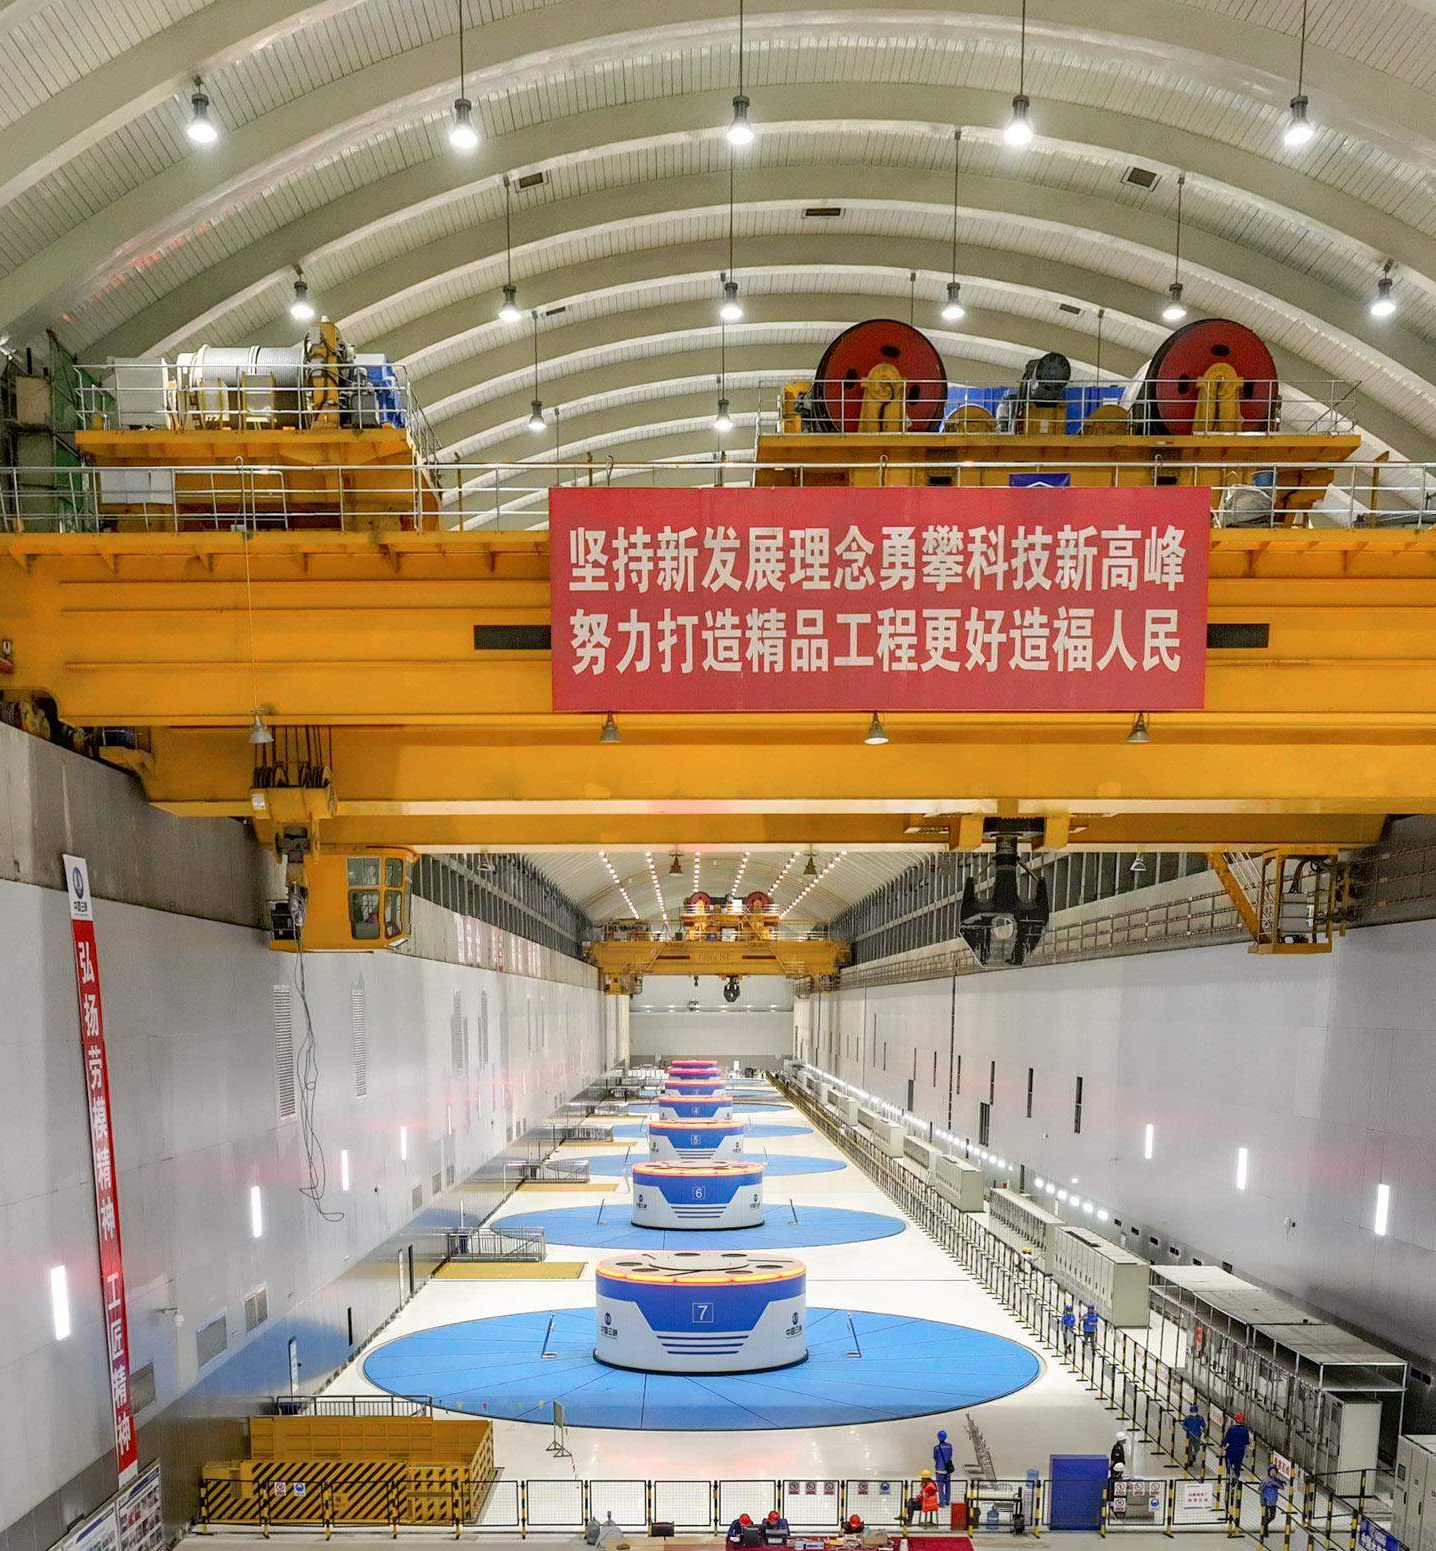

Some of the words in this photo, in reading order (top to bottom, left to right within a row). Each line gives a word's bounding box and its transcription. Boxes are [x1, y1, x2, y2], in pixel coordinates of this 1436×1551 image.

[569, 524, 1186, 593] 坚持新发展理念勇攀科技新高峰
[570, 608, 1182, 676] 努力打造精品工程更好造福人民
[78, 941, 117, 1242] 弘扬劳模精神
[107, 1273, 131, 1457] 工匠精神
[695, 1188, 703, 1199] 6
[697, 1305, 708, 1321] 7
